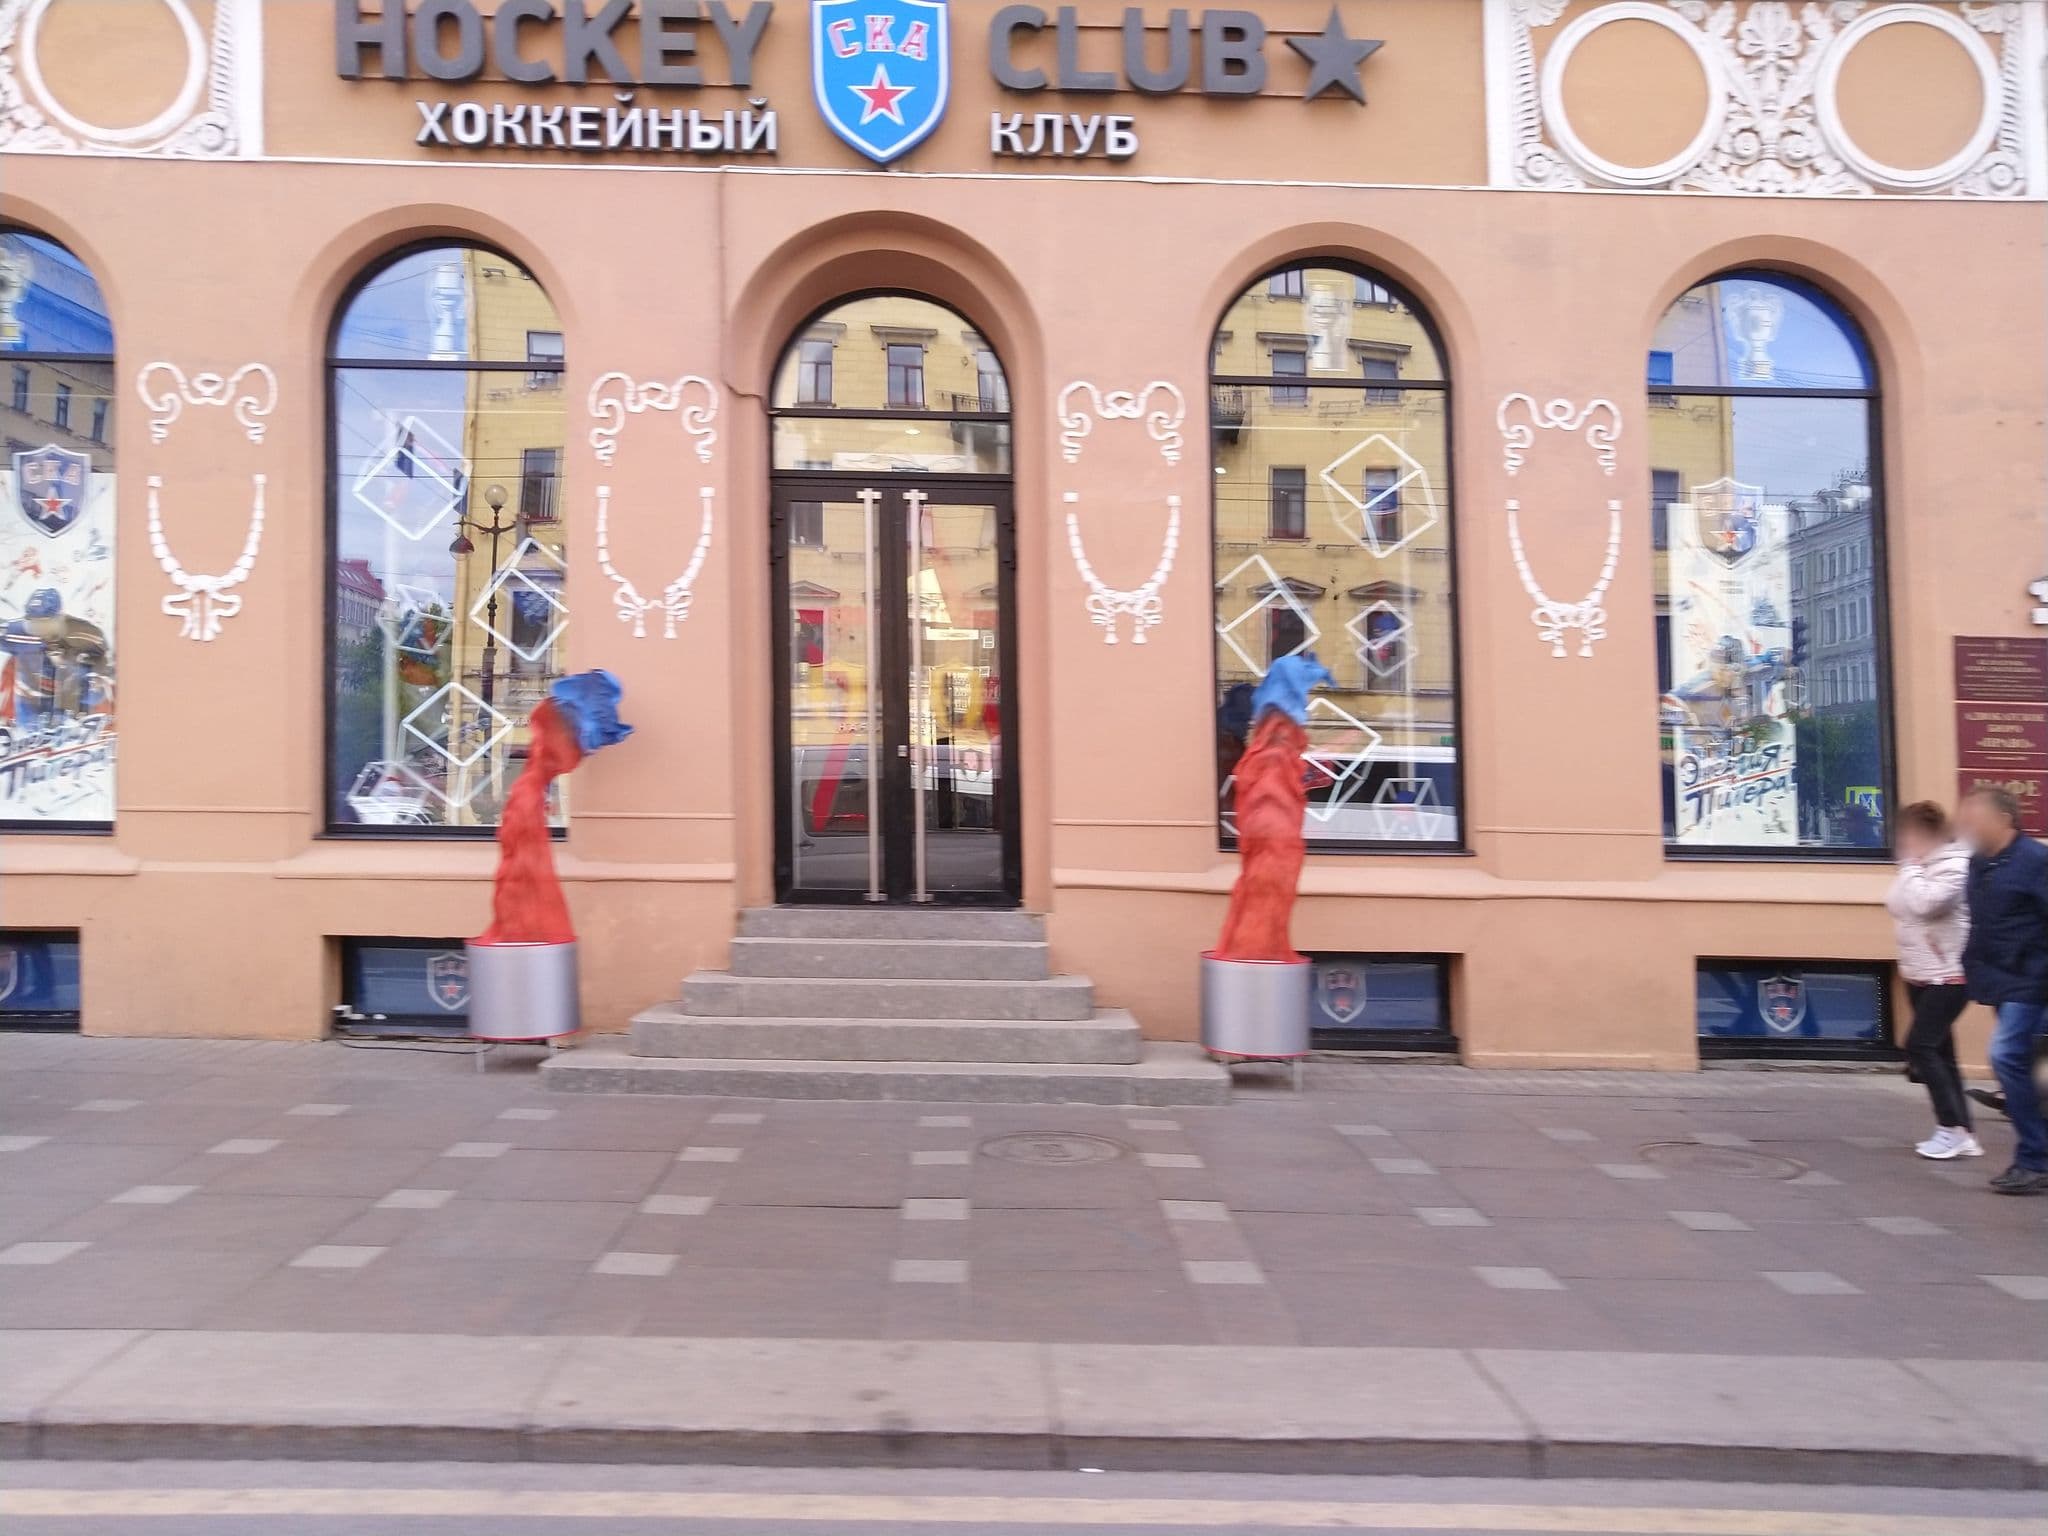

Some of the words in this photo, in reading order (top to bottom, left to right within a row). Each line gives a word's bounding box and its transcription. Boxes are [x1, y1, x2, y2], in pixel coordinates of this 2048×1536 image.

[336, 0, 773, 89] HOCKEY
[989, 4, 1268, 97] CLUB
[827, 14, 930, 62] СКА
[416, 91, 778, 153] ХОККЕЙНЫЙ
[990, 112, 1140, 160] КЛУБ
